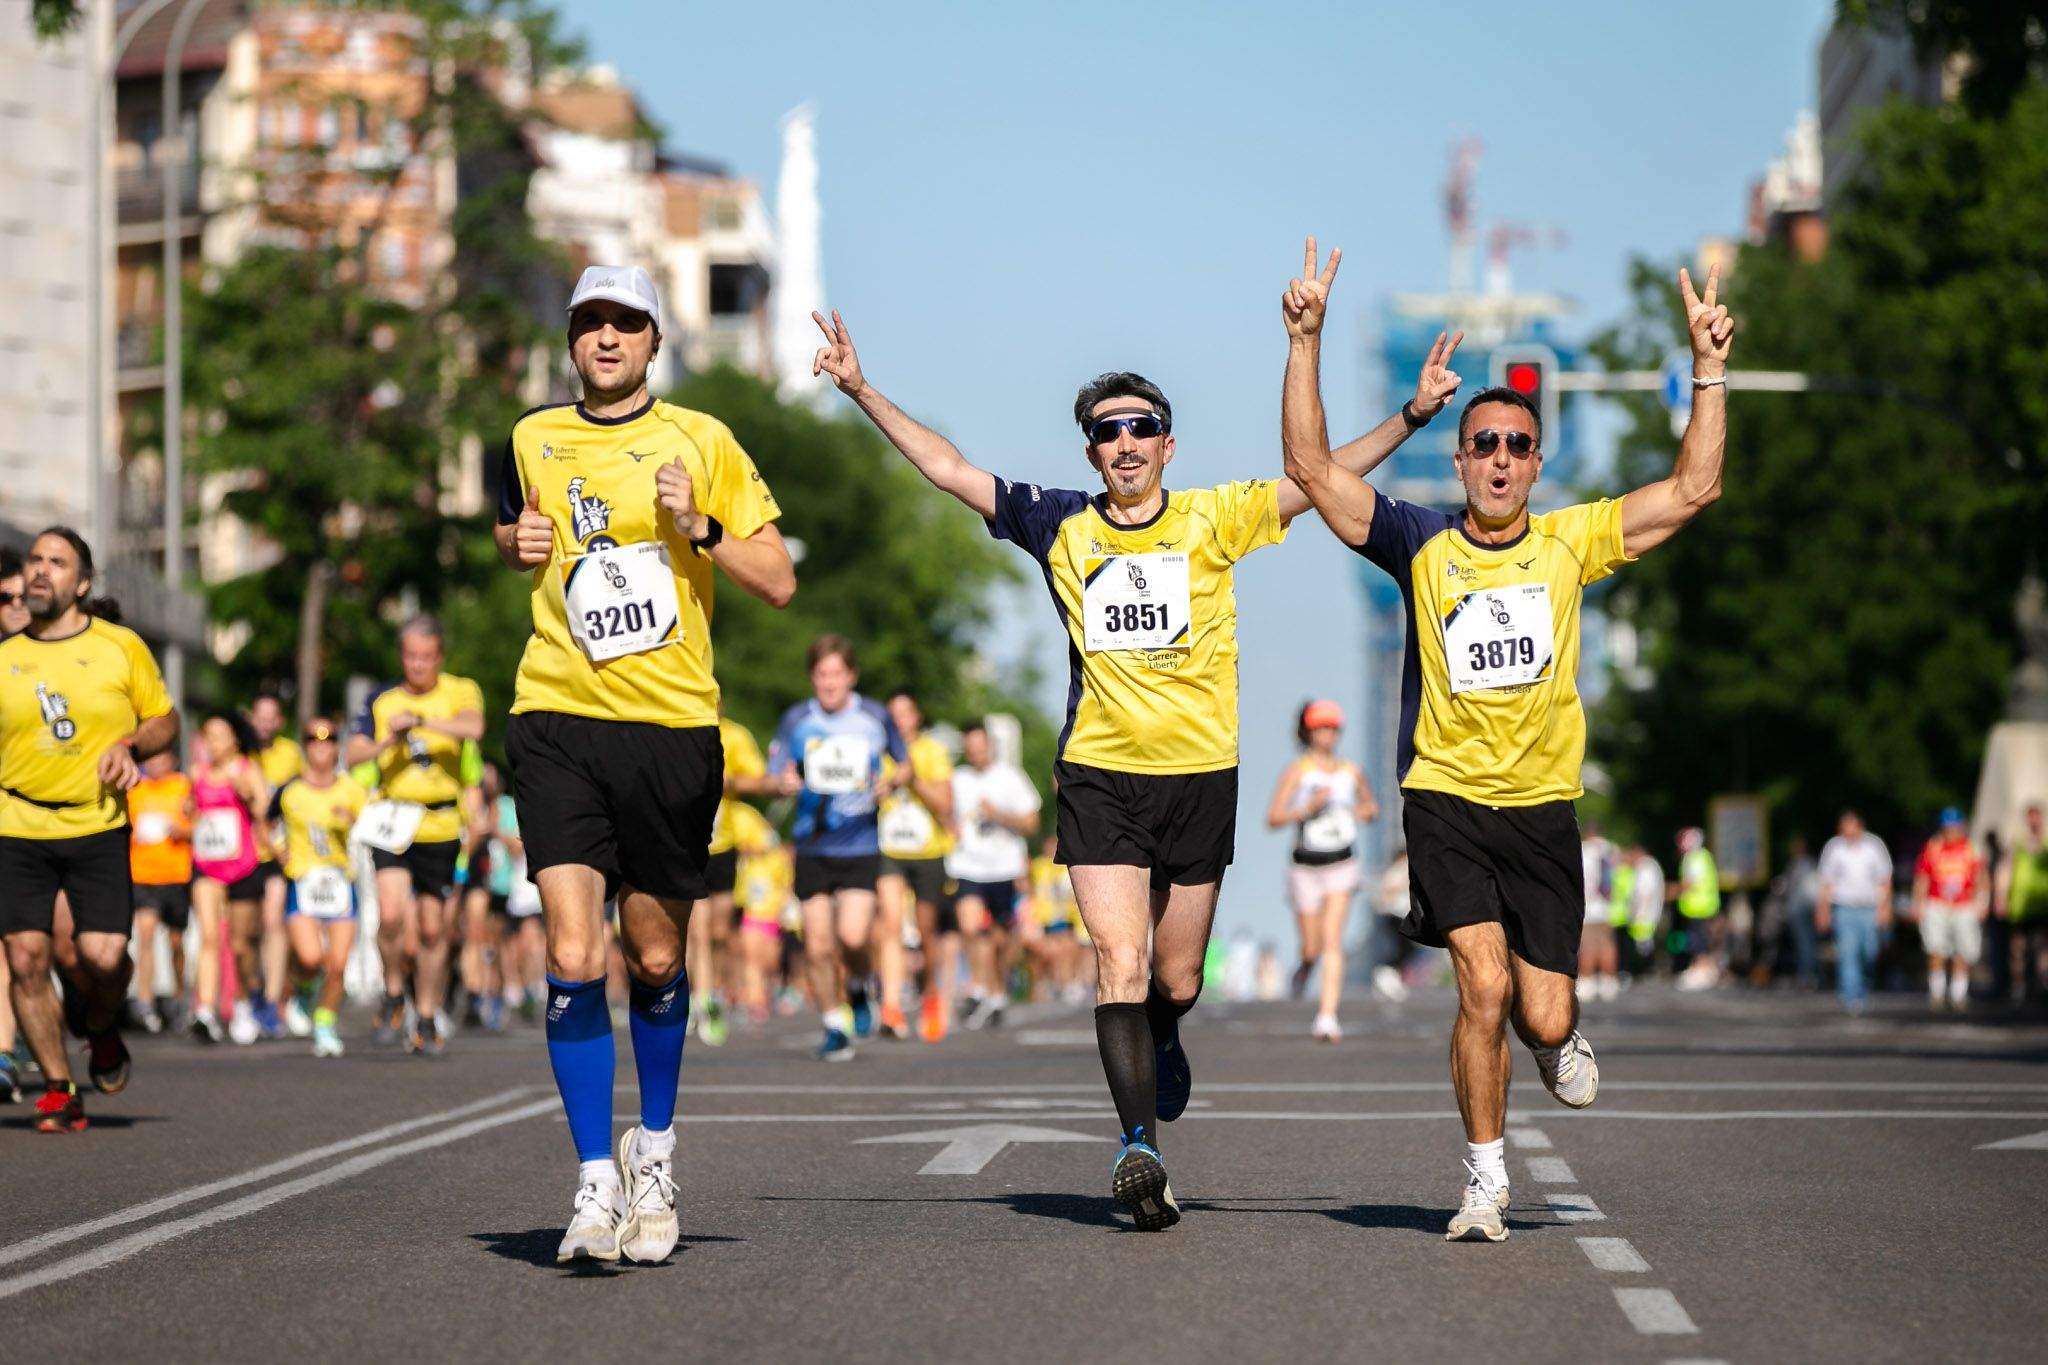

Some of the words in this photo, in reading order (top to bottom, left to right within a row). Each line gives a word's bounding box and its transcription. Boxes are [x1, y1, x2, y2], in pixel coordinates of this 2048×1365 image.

[585, 598, 657, 641] 3201
[1105, 603, 1168, 633] 3851
[1147, 651, 1178, 661] Carrera
[1149, 660, 1179, 670] Liberty
[1468, 636, 1535, 671] 3879
